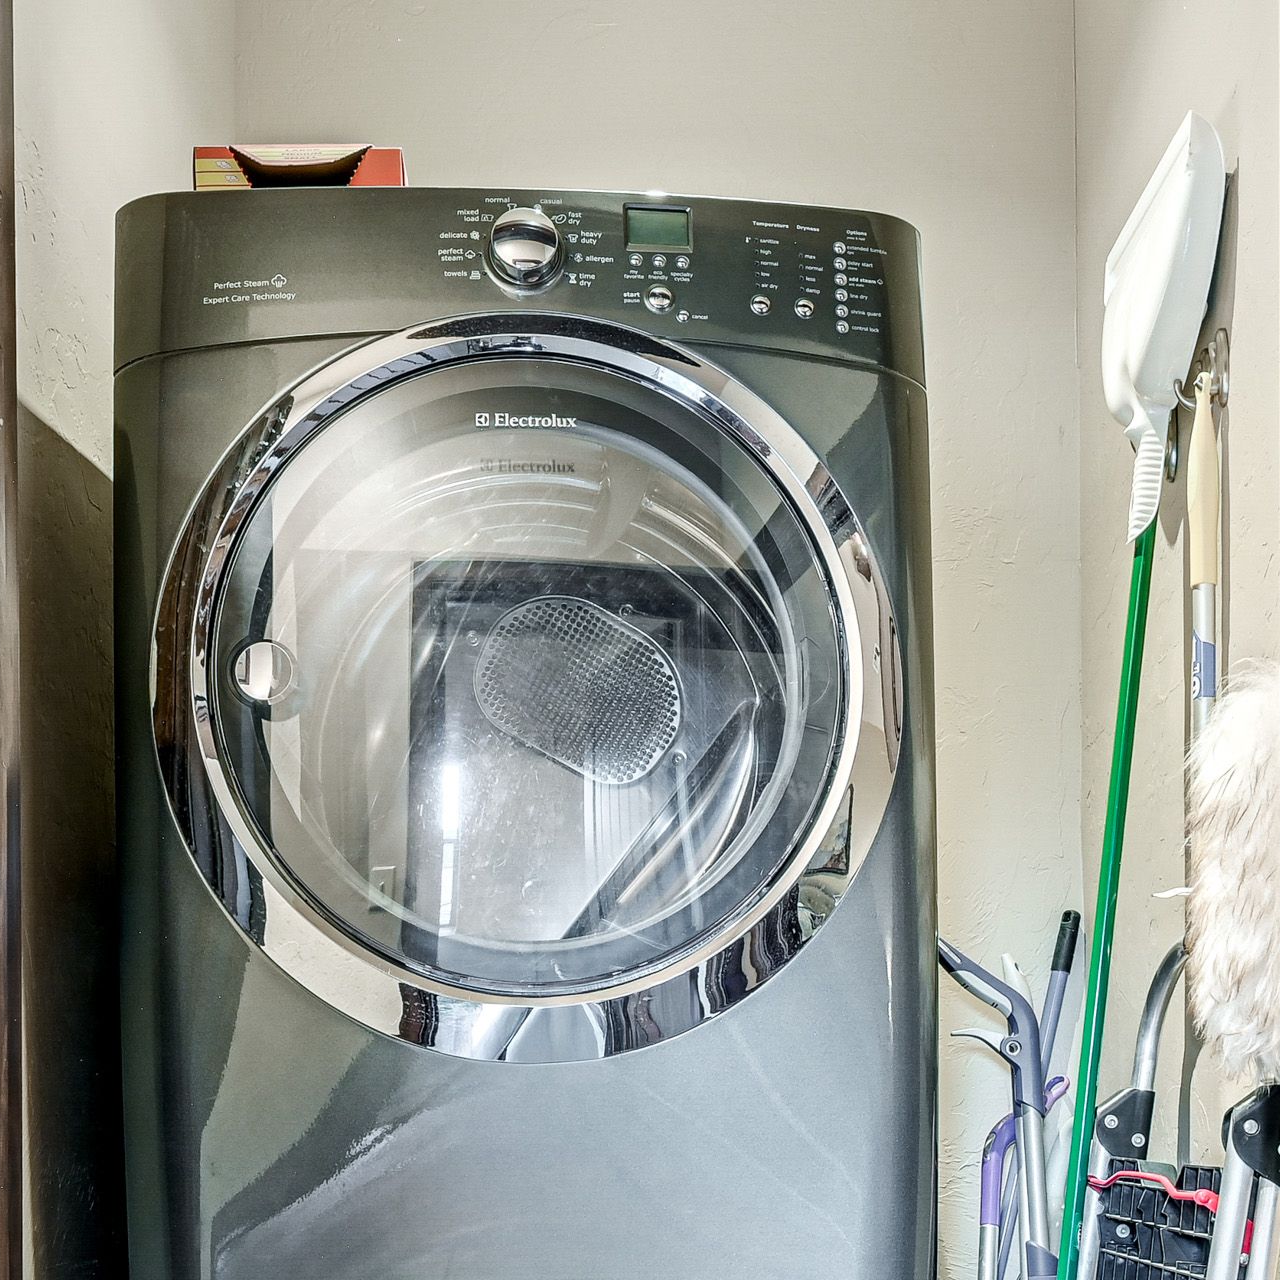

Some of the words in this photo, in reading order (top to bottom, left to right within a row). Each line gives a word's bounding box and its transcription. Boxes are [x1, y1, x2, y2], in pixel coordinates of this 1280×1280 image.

[568, 218, 581, 226] dry
[752, 220, 790, 230] Temperature
[796, 224, 820, 232] Dryness
[439, 232, 468, 240] delicate
[580, 230, 602, 239] heavy
[580, 237, 598, 246] duty
[437, 248, 464, 256] perfect
[585, 255, 614, 264] allergen
[579, 272, 596, 280] time
[213, 281, 242, 290] Perfect
[244, 280, 270, 288] Steam
[579, 278, 593, 288] dry
[203, 296, 230, 304] Expert
[252, 292, 296, 301] Technology
[494, 412, 577, 428] Electrolux
